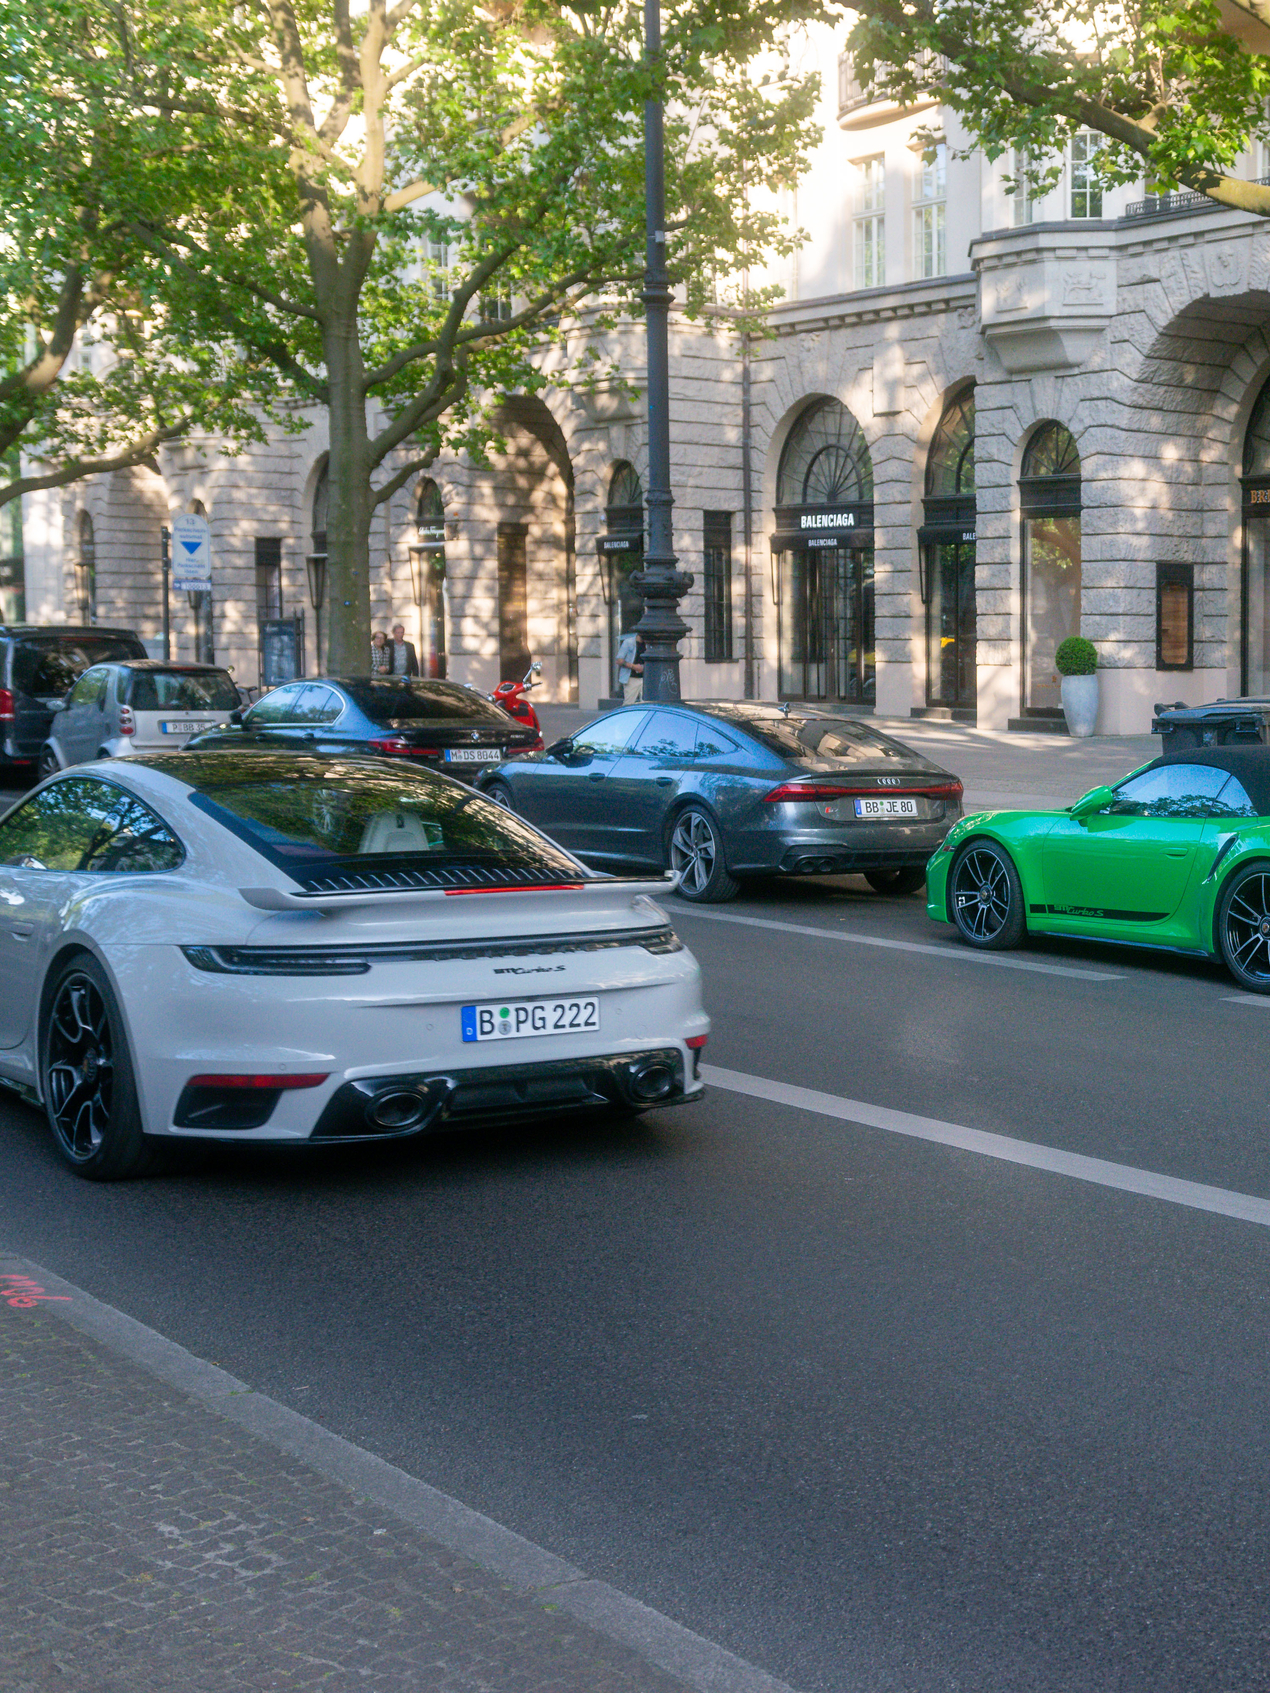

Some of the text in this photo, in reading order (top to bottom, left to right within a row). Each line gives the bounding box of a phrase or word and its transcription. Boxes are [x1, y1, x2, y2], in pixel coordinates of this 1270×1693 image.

[801, 513, 854, 528] BALENCIAGA
[808, 538, 838, 547] BALENCIAGA
[450, 750, 500, 760] M DS 8044
[865, 801, 913, 813] BB JE 80
[479, 1001, 597, 1036] B PG 222
